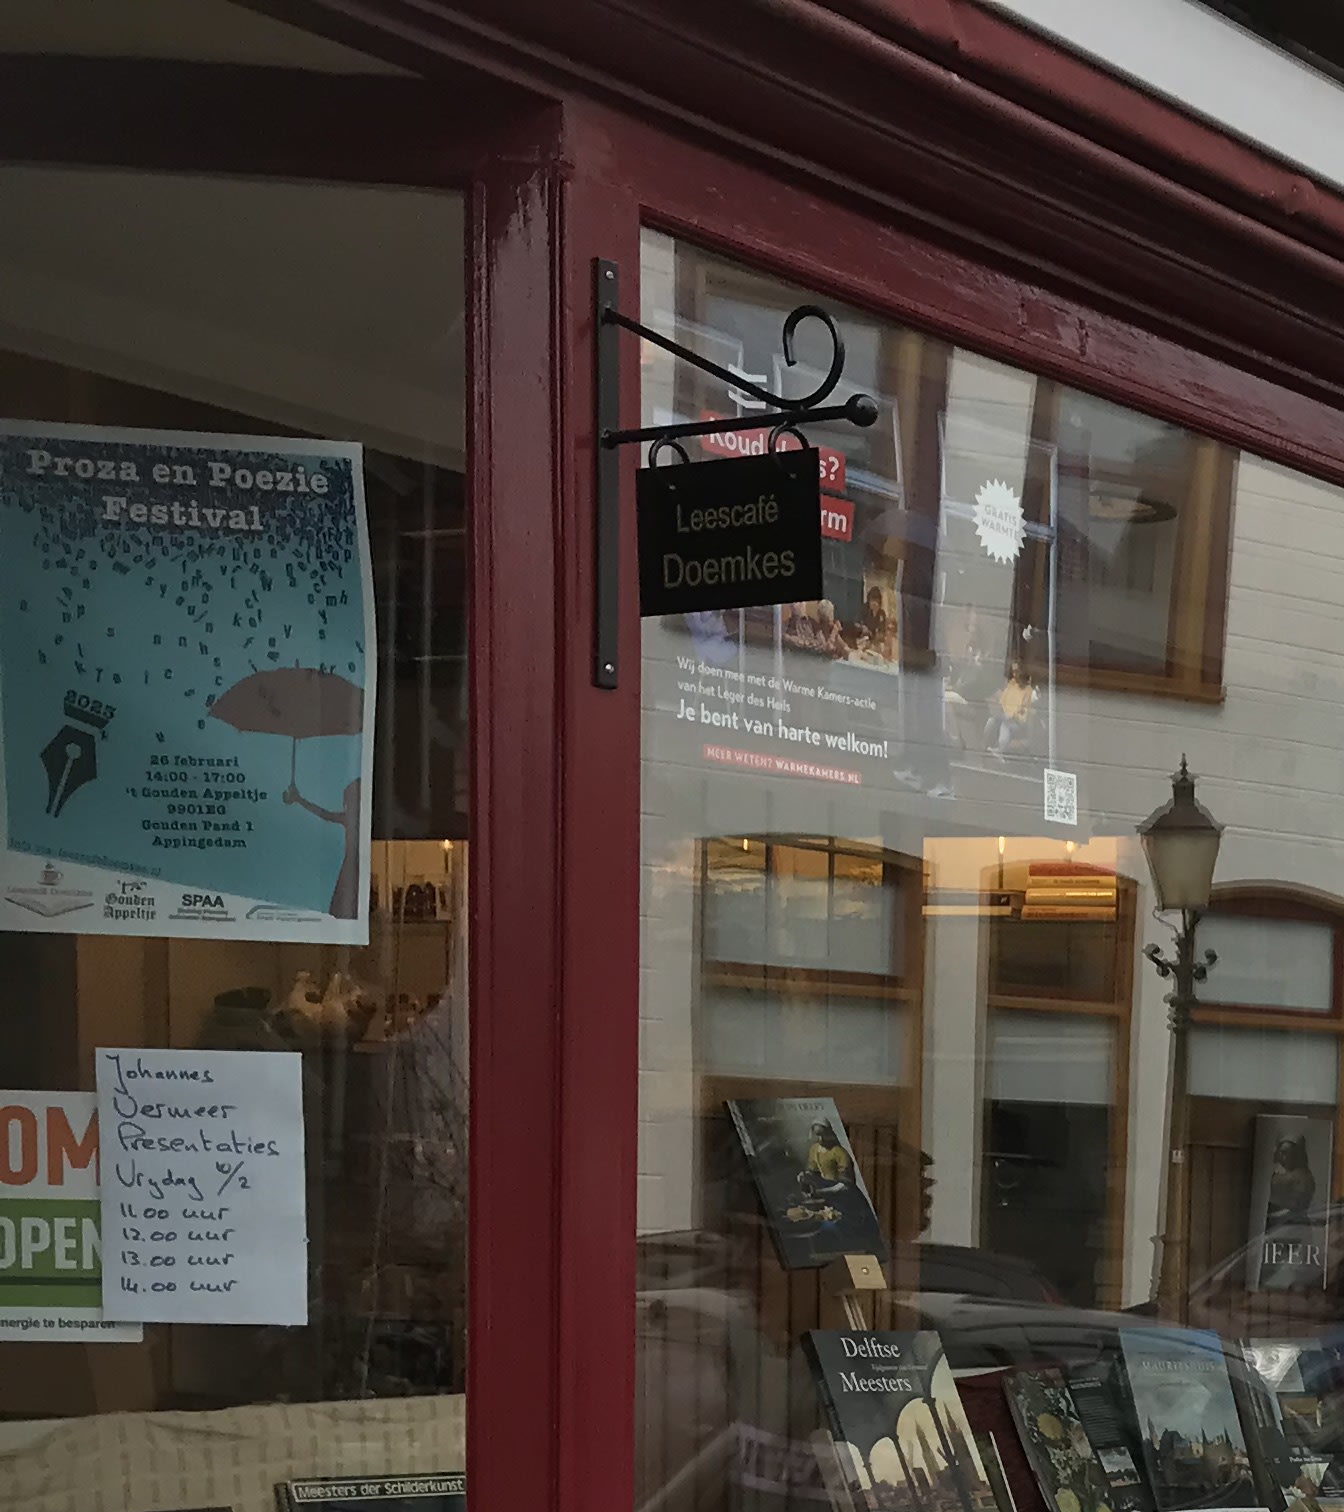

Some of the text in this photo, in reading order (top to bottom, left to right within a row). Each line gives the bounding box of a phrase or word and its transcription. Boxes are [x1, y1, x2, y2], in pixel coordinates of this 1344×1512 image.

[26, 449, 329, 494] Proza en Poezie
[101, 496, 264, 531] Festival
[676, 494, 780, 534] Leescafé
[662, 547, 796, 589] Doemkes
[676, 656, 878, 711] Wij doen mee met de Warme Kamers-actie
[677, 680, 791, 713] van het Leger des Heils
[676, 699, 888, 759] Je bent van harte welkom!
[150, 754, 239, 768] 26 februari
[203, 771, 246, 784] 17:00
[141, 787, 198, 799] Gouden
[203, 788, 268, 803] Appeltje
[141, 820, 197, 832] Gouden
[202, 820, 240, 832] Pand
[151, 835, 247, 850] Appingedam
[182, 894, 225, 908] SPAA
[105, 1055, 214, 1096] Johannes
[113, 1095, 238, 1120] Vermeer
[0, 1105, 100, 1186] OM
[117, 1121, 280, 1156] Presentaties
[182, 1207, 230, 1220] uur
[122, 1228, 235, 1243] 12.00 uur
[120, 1251, 234, 1267] 13.00 uur
[190, 1280, 238, 1294] uur
[0, 1318, 41, 1331] nergie
[43, 1318, 56, 1329] te
[840, 1337, 901, 1358] Delftse
[839, 1371, 913, 1393] Meesters
[298, 1478, 465, 1499] Meesters der Schilderkunst
